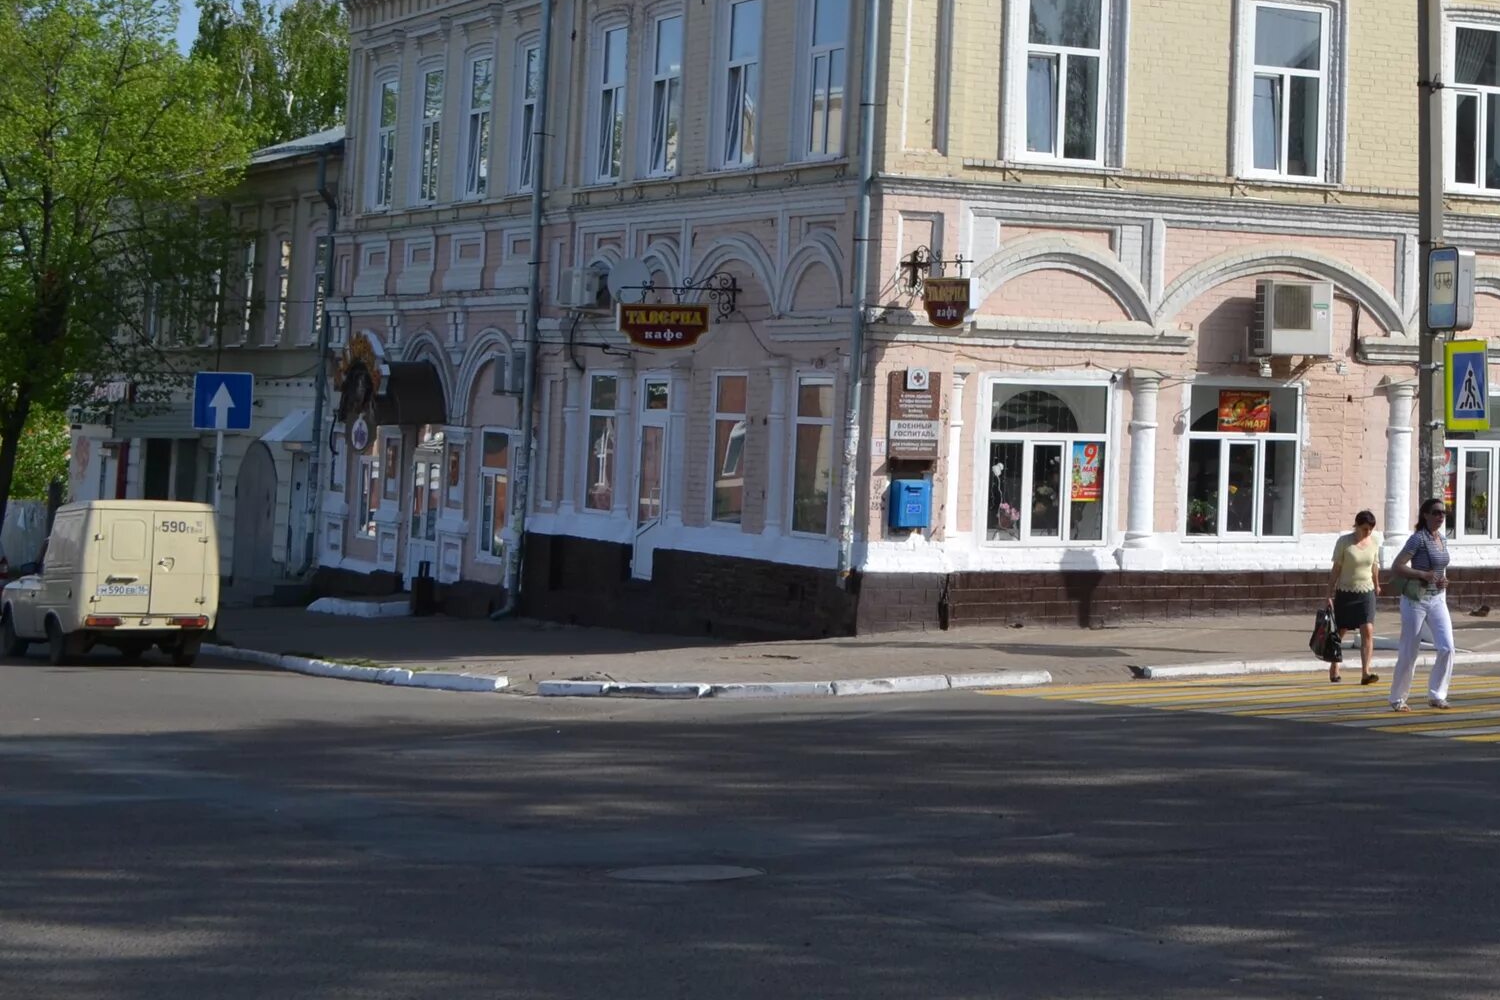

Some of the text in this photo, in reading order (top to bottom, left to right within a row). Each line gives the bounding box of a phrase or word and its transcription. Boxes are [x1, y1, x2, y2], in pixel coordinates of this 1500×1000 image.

[644, 329, 683, 341] кафе
[897, 422, 932, 430] ВОЕННЫЙ
[894, 430, 935, 438] ГОСПИТАЛЬ
[1084, 443, 1099, 465] 9
